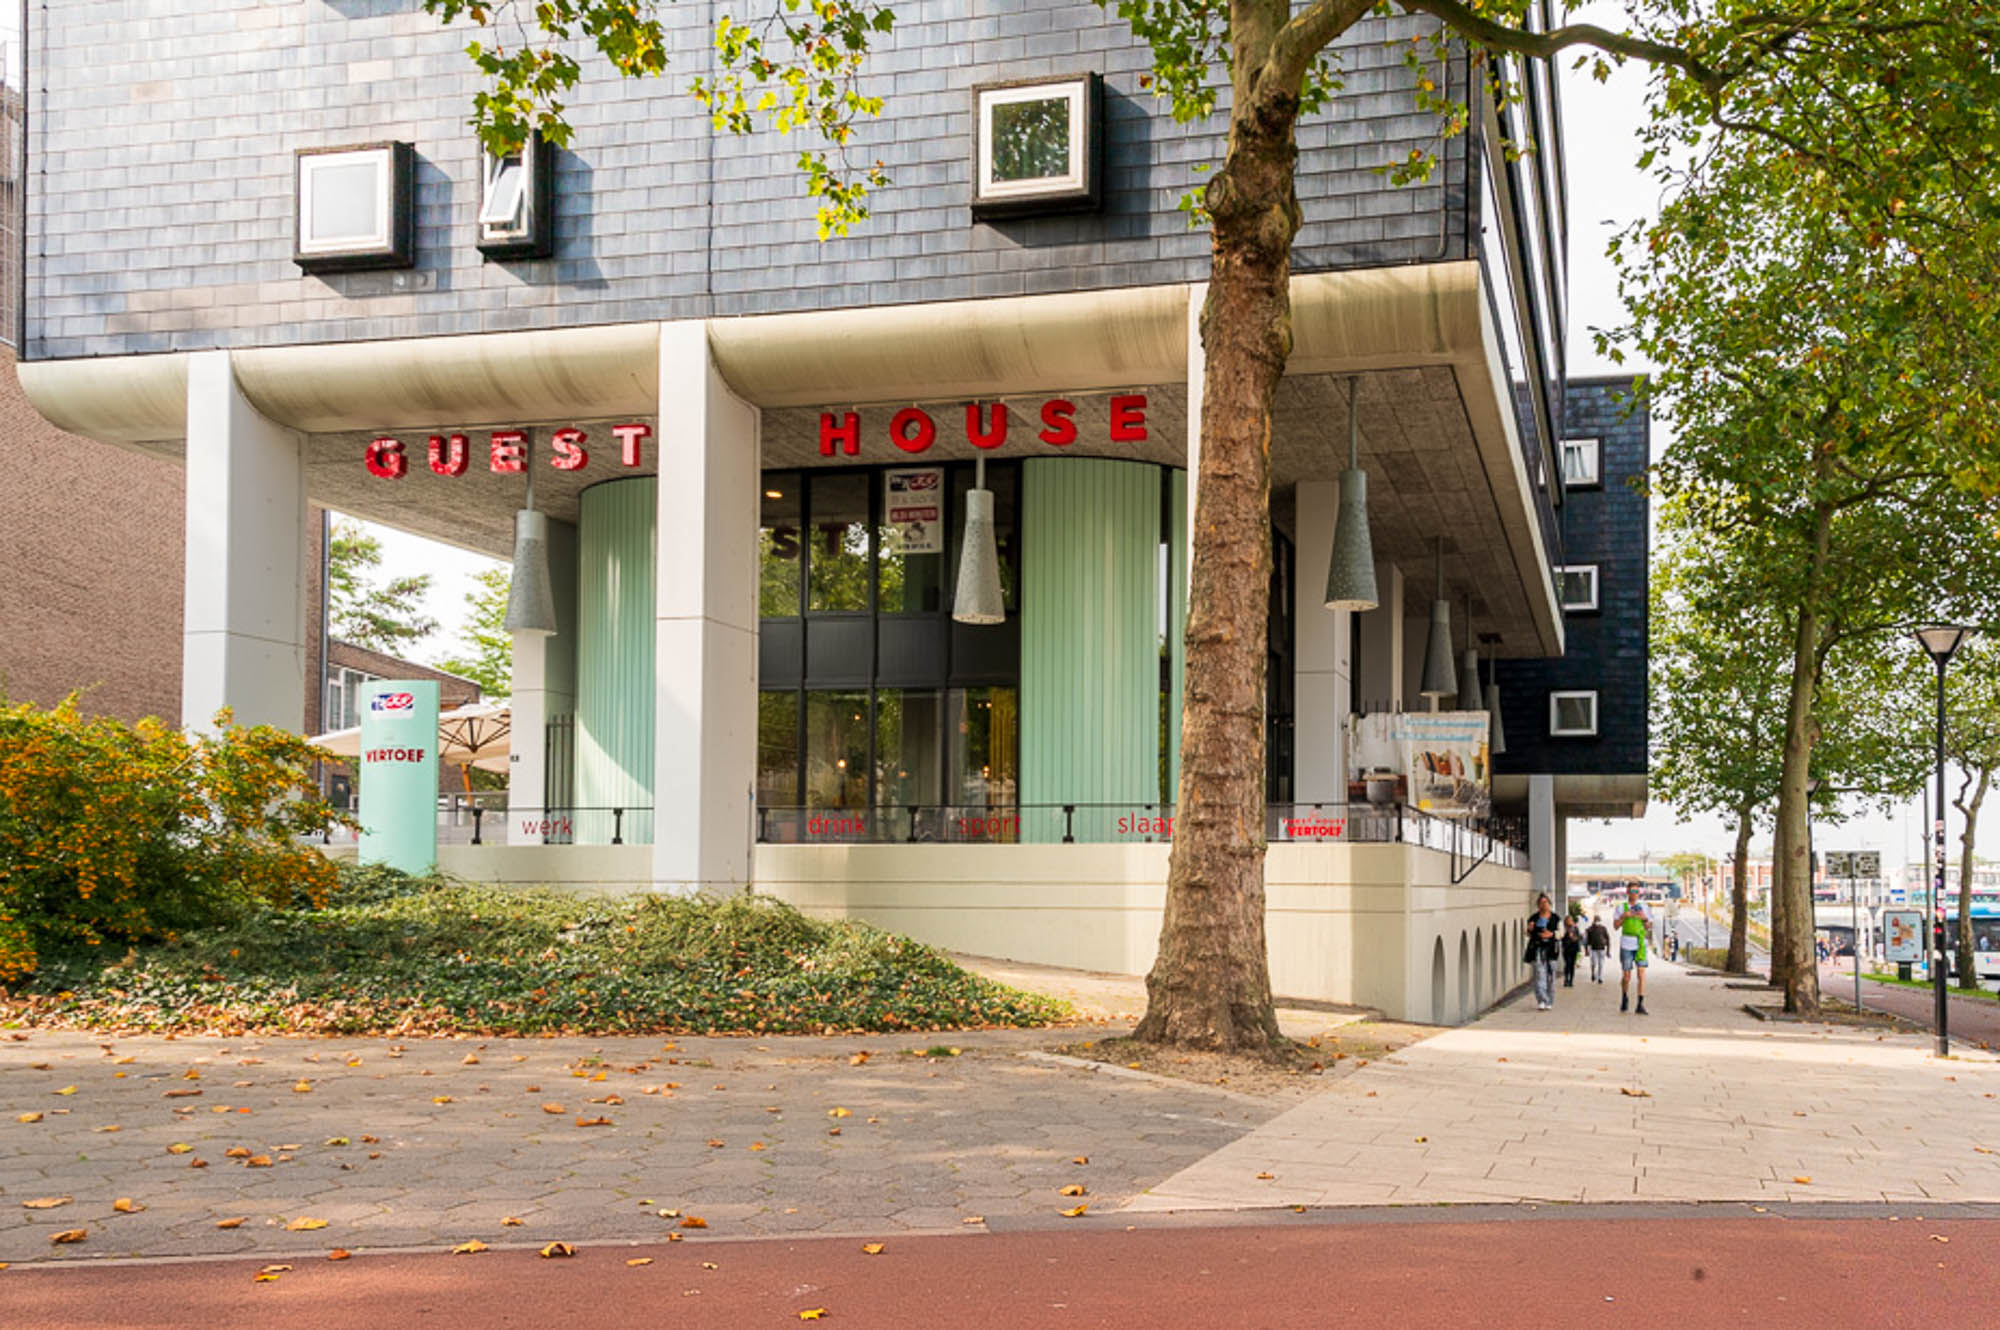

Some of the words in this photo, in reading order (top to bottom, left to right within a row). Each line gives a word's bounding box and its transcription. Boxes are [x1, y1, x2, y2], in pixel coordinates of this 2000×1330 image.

[364, 424, 651, 480] GUEST
[819, 395, 1148, 457] HOUSE
[365, 748, 425, 763] VERTOEF
[522, 815, 573, 836] werk
[808, 813, 866, 835] drink
[958, 813, 1022, 838] sport
[1117, 811, 1176, 838] slaap
[1287, 825, 1343, 838] VERTOEF
